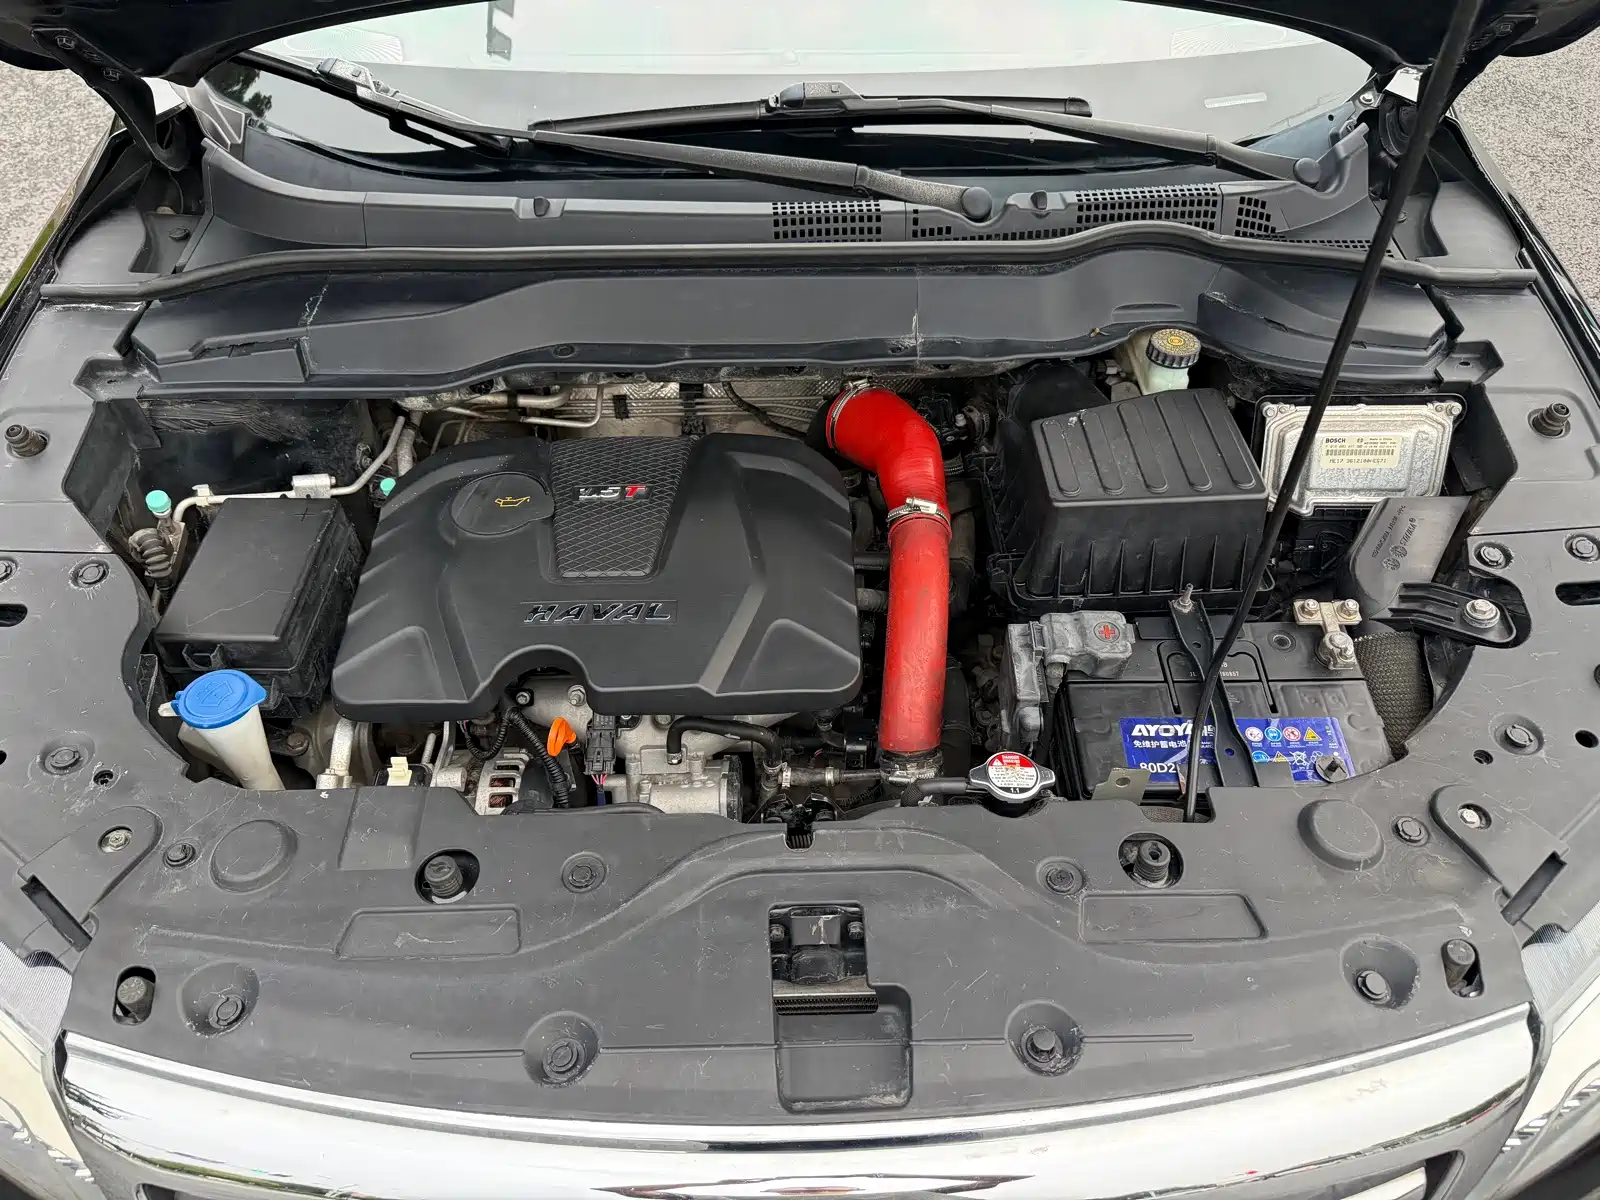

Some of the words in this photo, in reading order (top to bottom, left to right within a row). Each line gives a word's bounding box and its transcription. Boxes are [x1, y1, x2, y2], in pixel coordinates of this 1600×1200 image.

[524, 603, 671, 623] HAVAL
[1133, 740, 1188, 749] 免维护蓄电池
[1140, 763, 1176, 773] 80D2
